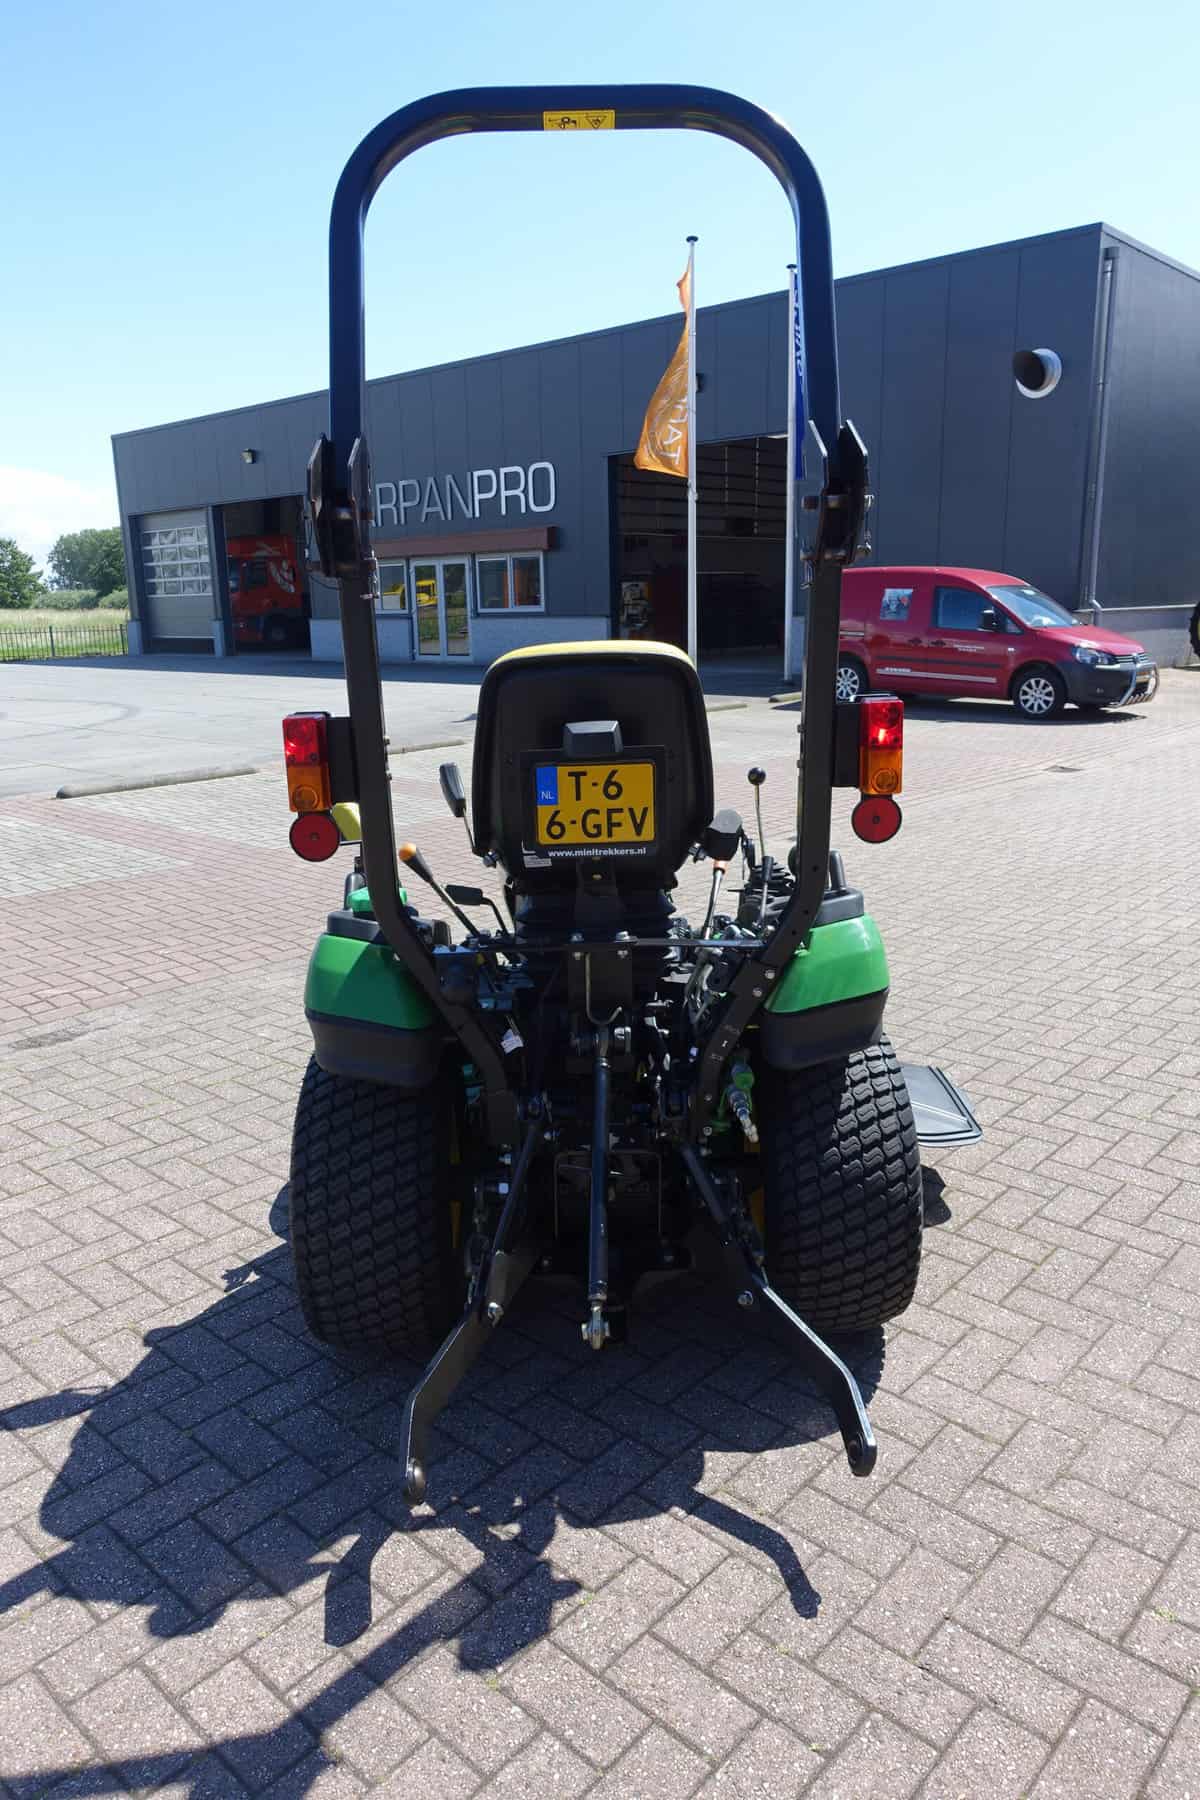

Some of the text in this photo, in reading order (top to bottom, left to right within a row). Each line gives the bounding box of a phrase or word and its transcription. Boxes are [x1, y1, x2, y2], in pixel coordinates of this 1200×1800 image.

[370, 461, 556, 527] RPANPRO
[541, 791, 555, 800] NL
[568, 769, 623, 801] T-6
[546, 806, 649, 840] 6-GFV
[547, 847, 647, 858] www.minitrekkers.nl
